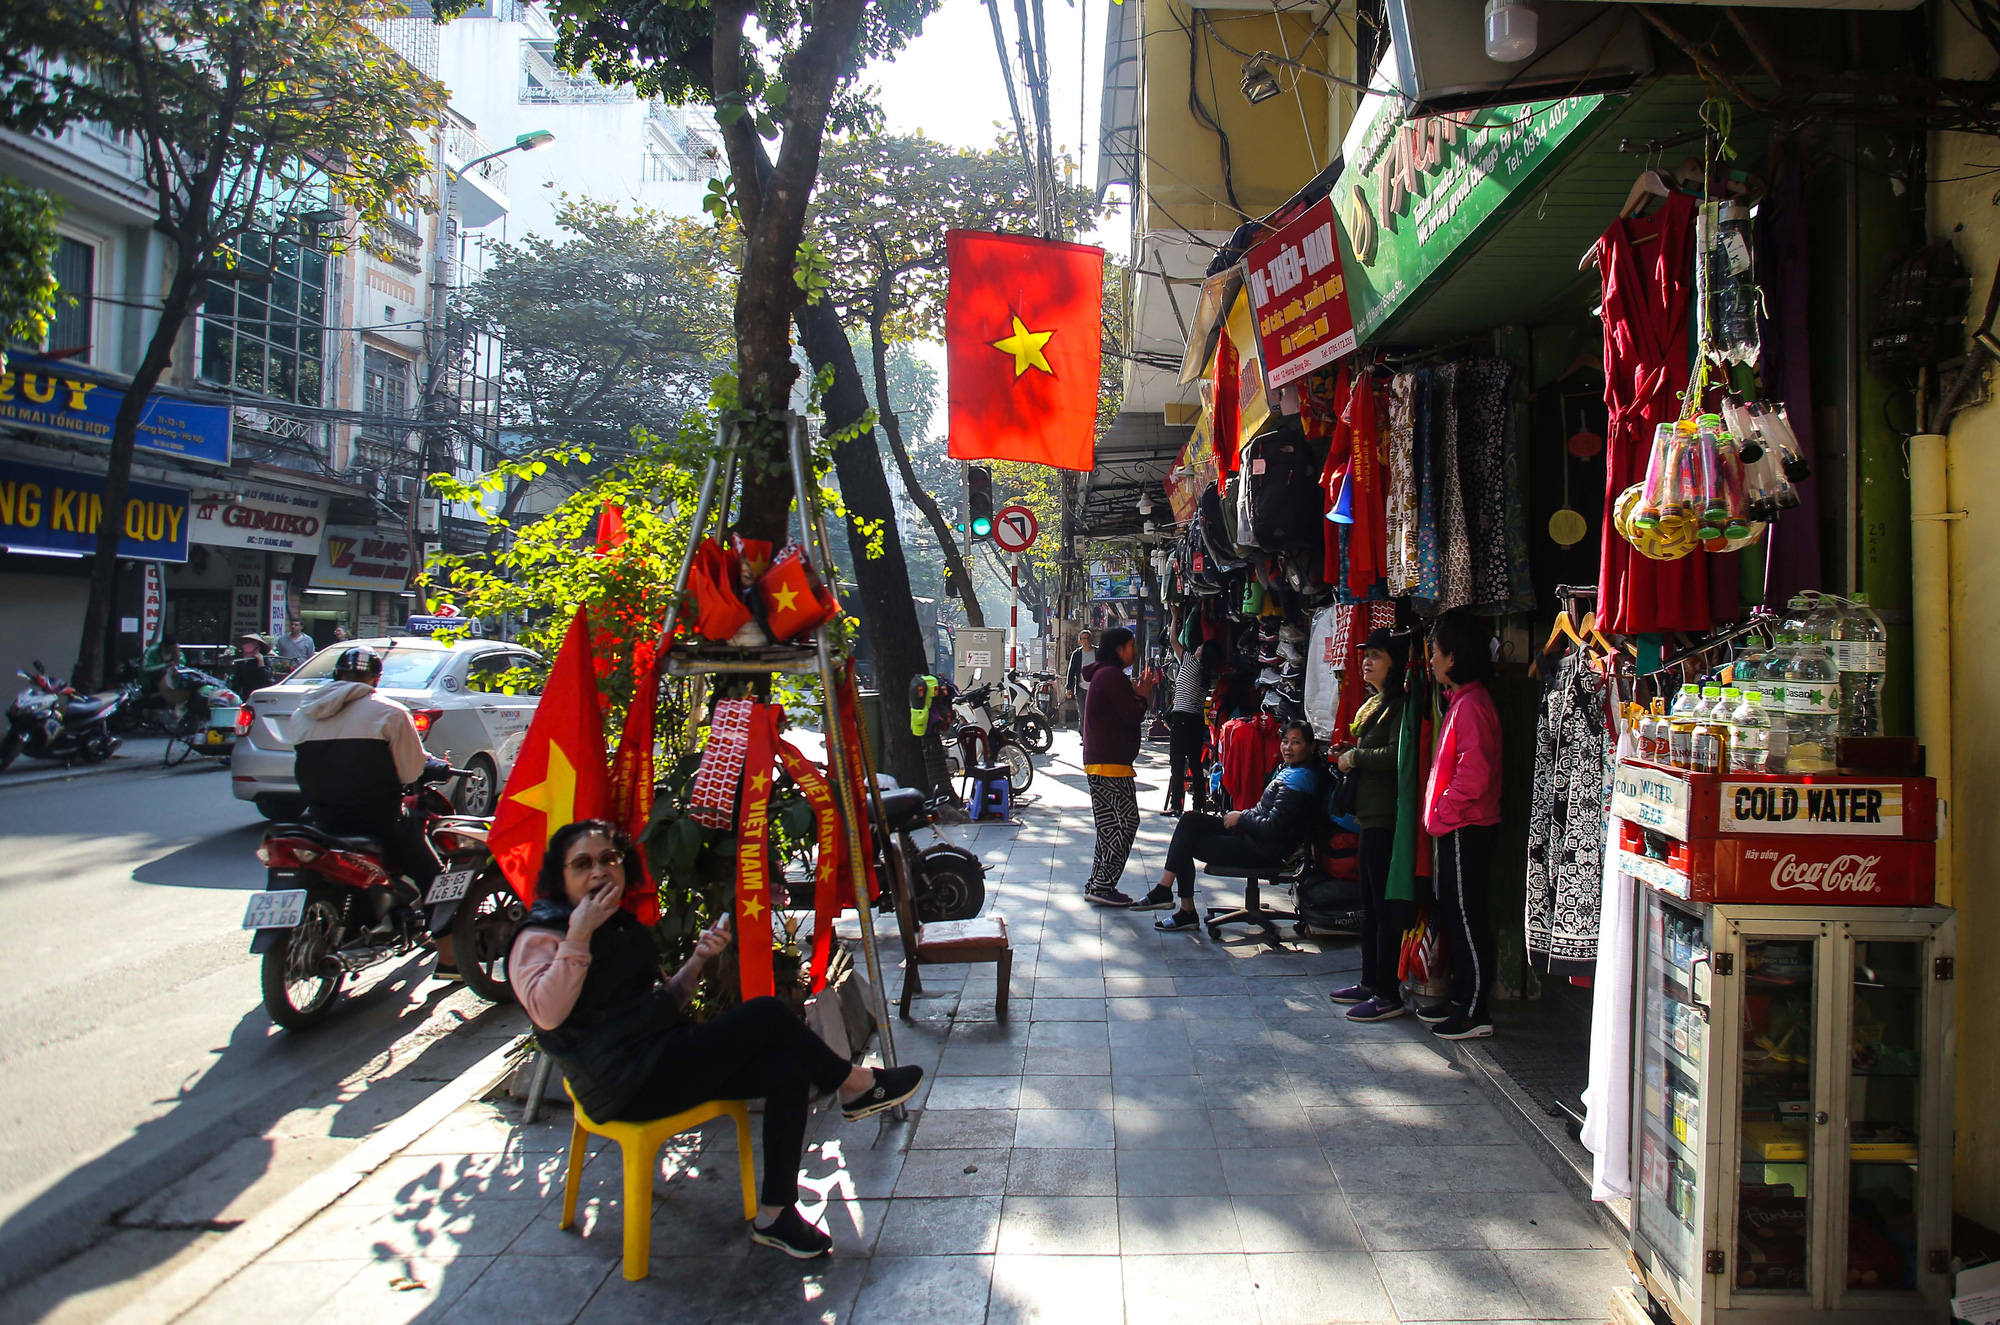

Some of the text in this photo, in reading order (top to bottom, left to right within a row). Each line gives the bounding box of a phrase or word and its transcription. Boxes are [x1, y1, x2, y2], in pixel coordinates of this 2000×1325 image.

[1504, 149, 1523, 176] Tel:
[1523, 119, 1548, 158] 0934
[1548, 101, 1569, 130] 402
[1413, 126, 1490, 227] Tailor make 24 hour
[1416, 225, 1430, 248] We
[1428, 201, 1451, 236] bring
[1450, 173, 1471, 217] good
[1470, 143, 1499, 188] things
[1500, 129, 1512, 154] to
[1370, 301, 1384, 321] Hang
[1381, 289, 1397, 309] Bong
[125, 498, 185, 542] QUY
[222, 504, 319, 537] GIMIKO
[361, 534, 410, 561] VÀNG
[235, 573, 262, 588] HOA
[237, 594, 258, 608] SIM
[272, 606, 284, 619] HOA
[1786, 688, 1812, 699] Dasani
[1615, 779, 1674, 804] COLD WATER
[1735, 786, 1883, 823] COLD WATER
[797, 772, 836, 855] VIỆT NAM
[740, 798, 768, 890] VIỆT NAM
[1745, 848, 1779, 862] Hãy uống
[1770, 853, 1881, 892] Coca-Cola
[256, 894, 298, 909] 29-V7
[429, 888, 464, 902] 146.34
[250, 909, 298, 926] 121.66
[1743, 1207, 1807, 1228] Fanta
